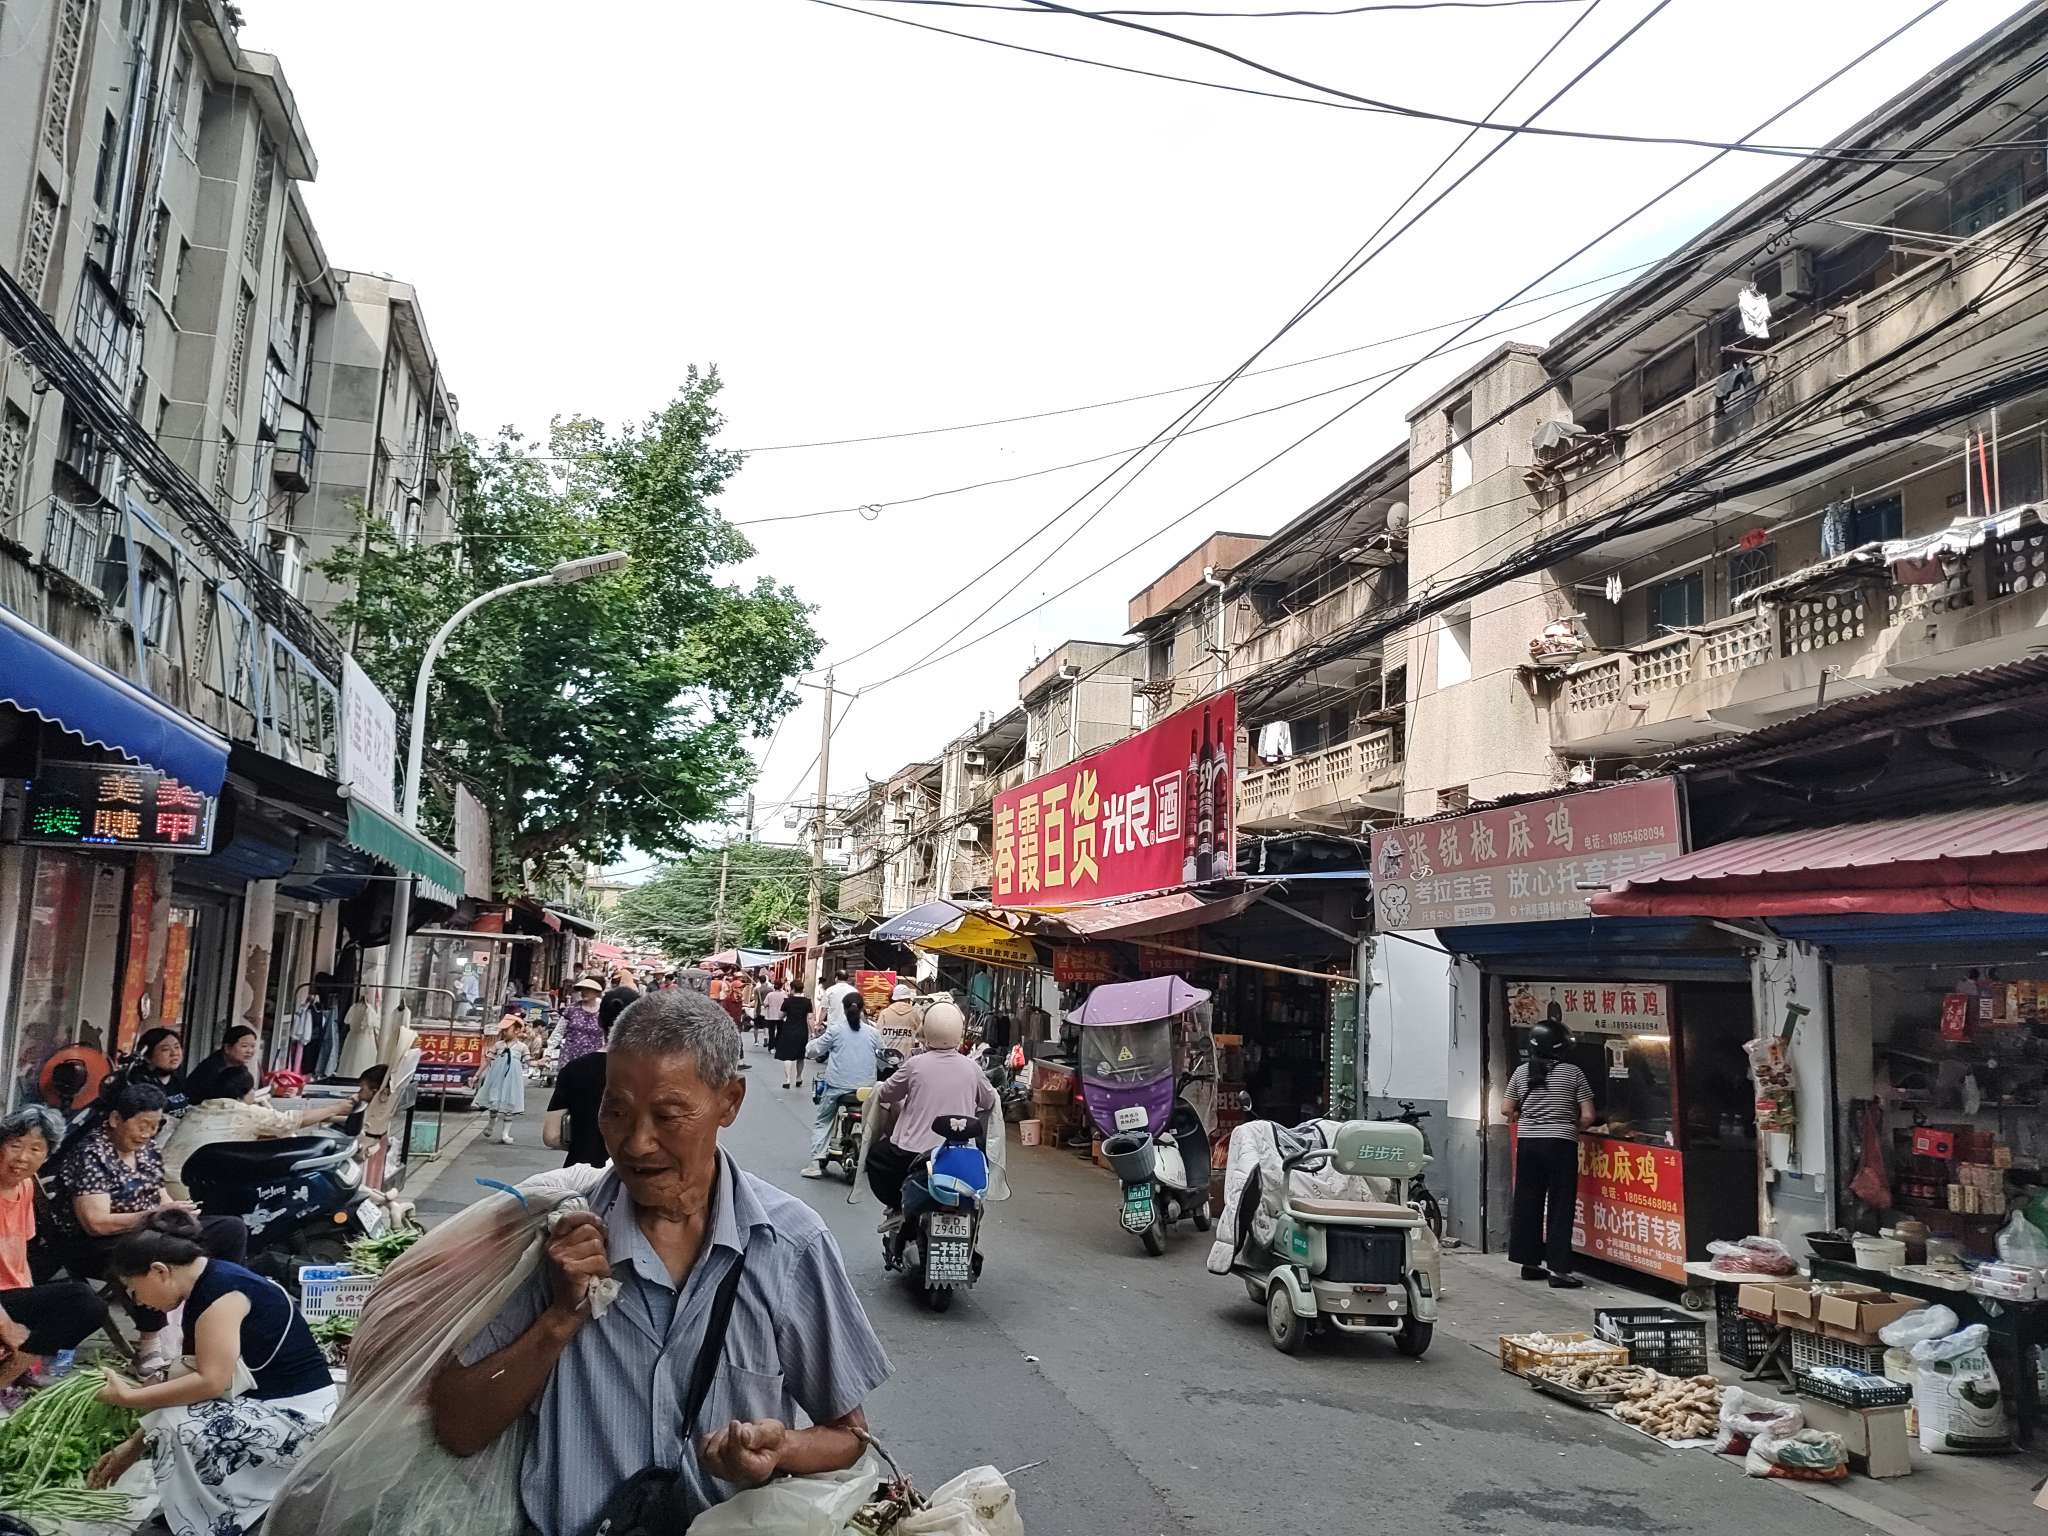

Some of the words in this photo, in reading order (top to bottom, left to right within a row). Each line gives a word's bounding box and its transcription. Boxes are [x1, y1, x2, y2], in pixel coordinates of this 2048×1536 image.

[995, 768, 1099, 895] 春霞百货
[1408, 801, 1574, 871] 张锐椒麻鸡
[1415, 874, 1494, 904] 考拉宝宝
[1564, 989, 1659, 1016] 张锐椒麻鸡
[882, 1027, 913, 1037] OTHERS
[1358, 1144, 1406, 1161] 步步先
[934, 1224, 967, 1236] Z9405
[1593, 1202, 1683, 1251] 放心托育专家
